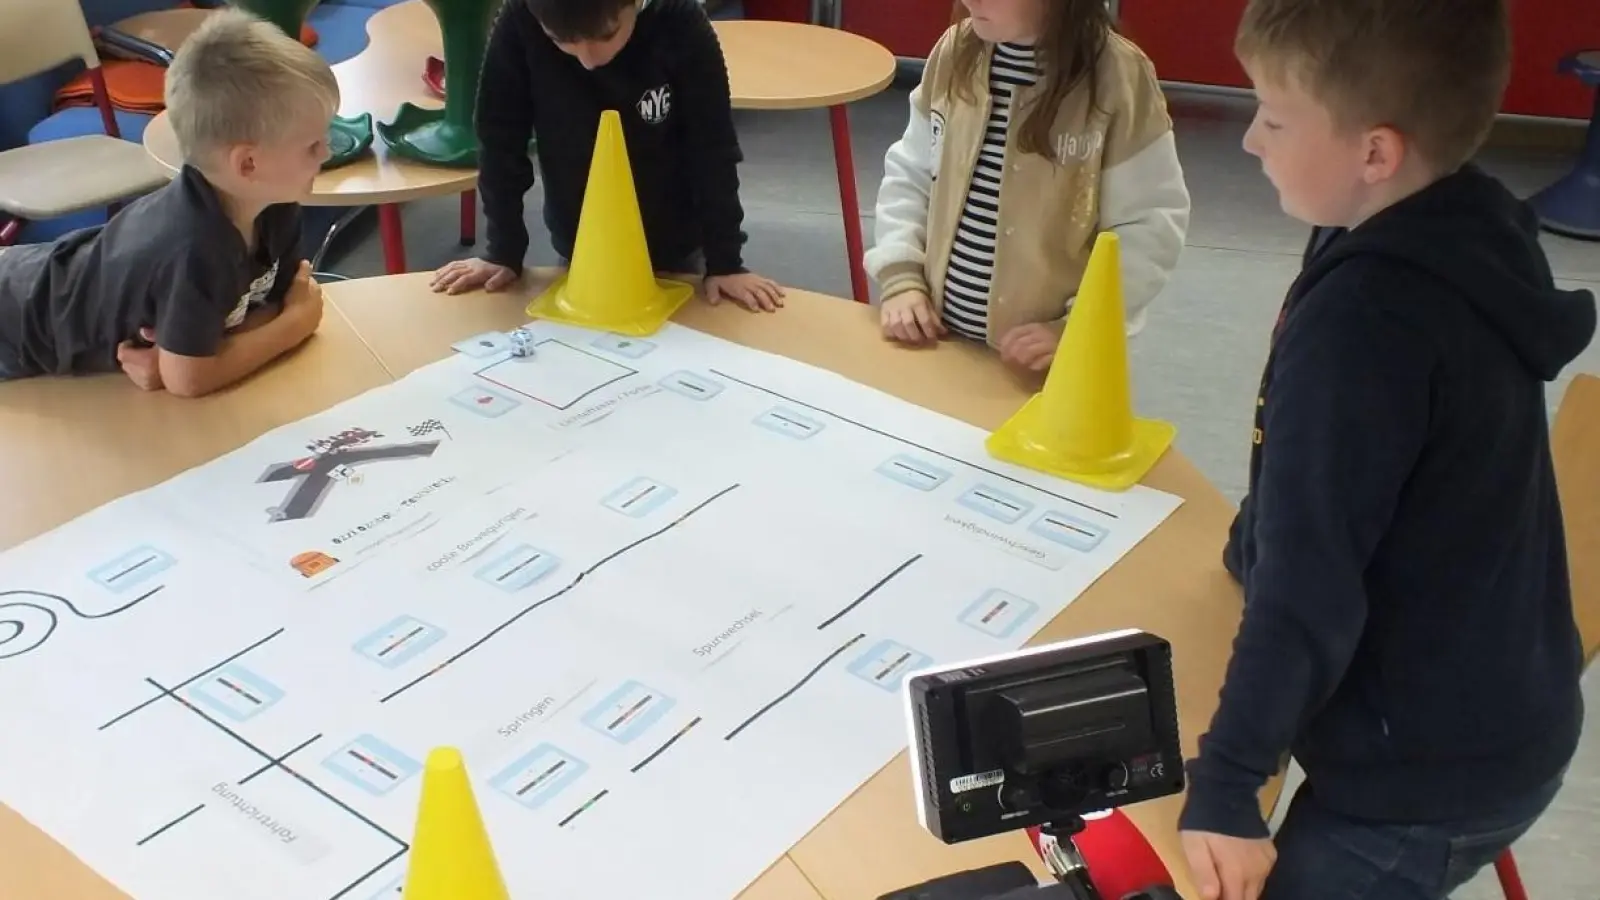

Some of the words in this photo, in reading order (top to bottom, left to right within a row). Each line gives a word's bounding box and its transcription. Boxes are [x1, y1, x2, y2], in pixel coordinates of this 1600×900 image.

[641, 87, 671, 120] NYC
[692, 608, 763, 658] Spurwechsel
[497, 695, 555, 739] Springen
[211, 781, 298, 844] Fahrtrichtung
